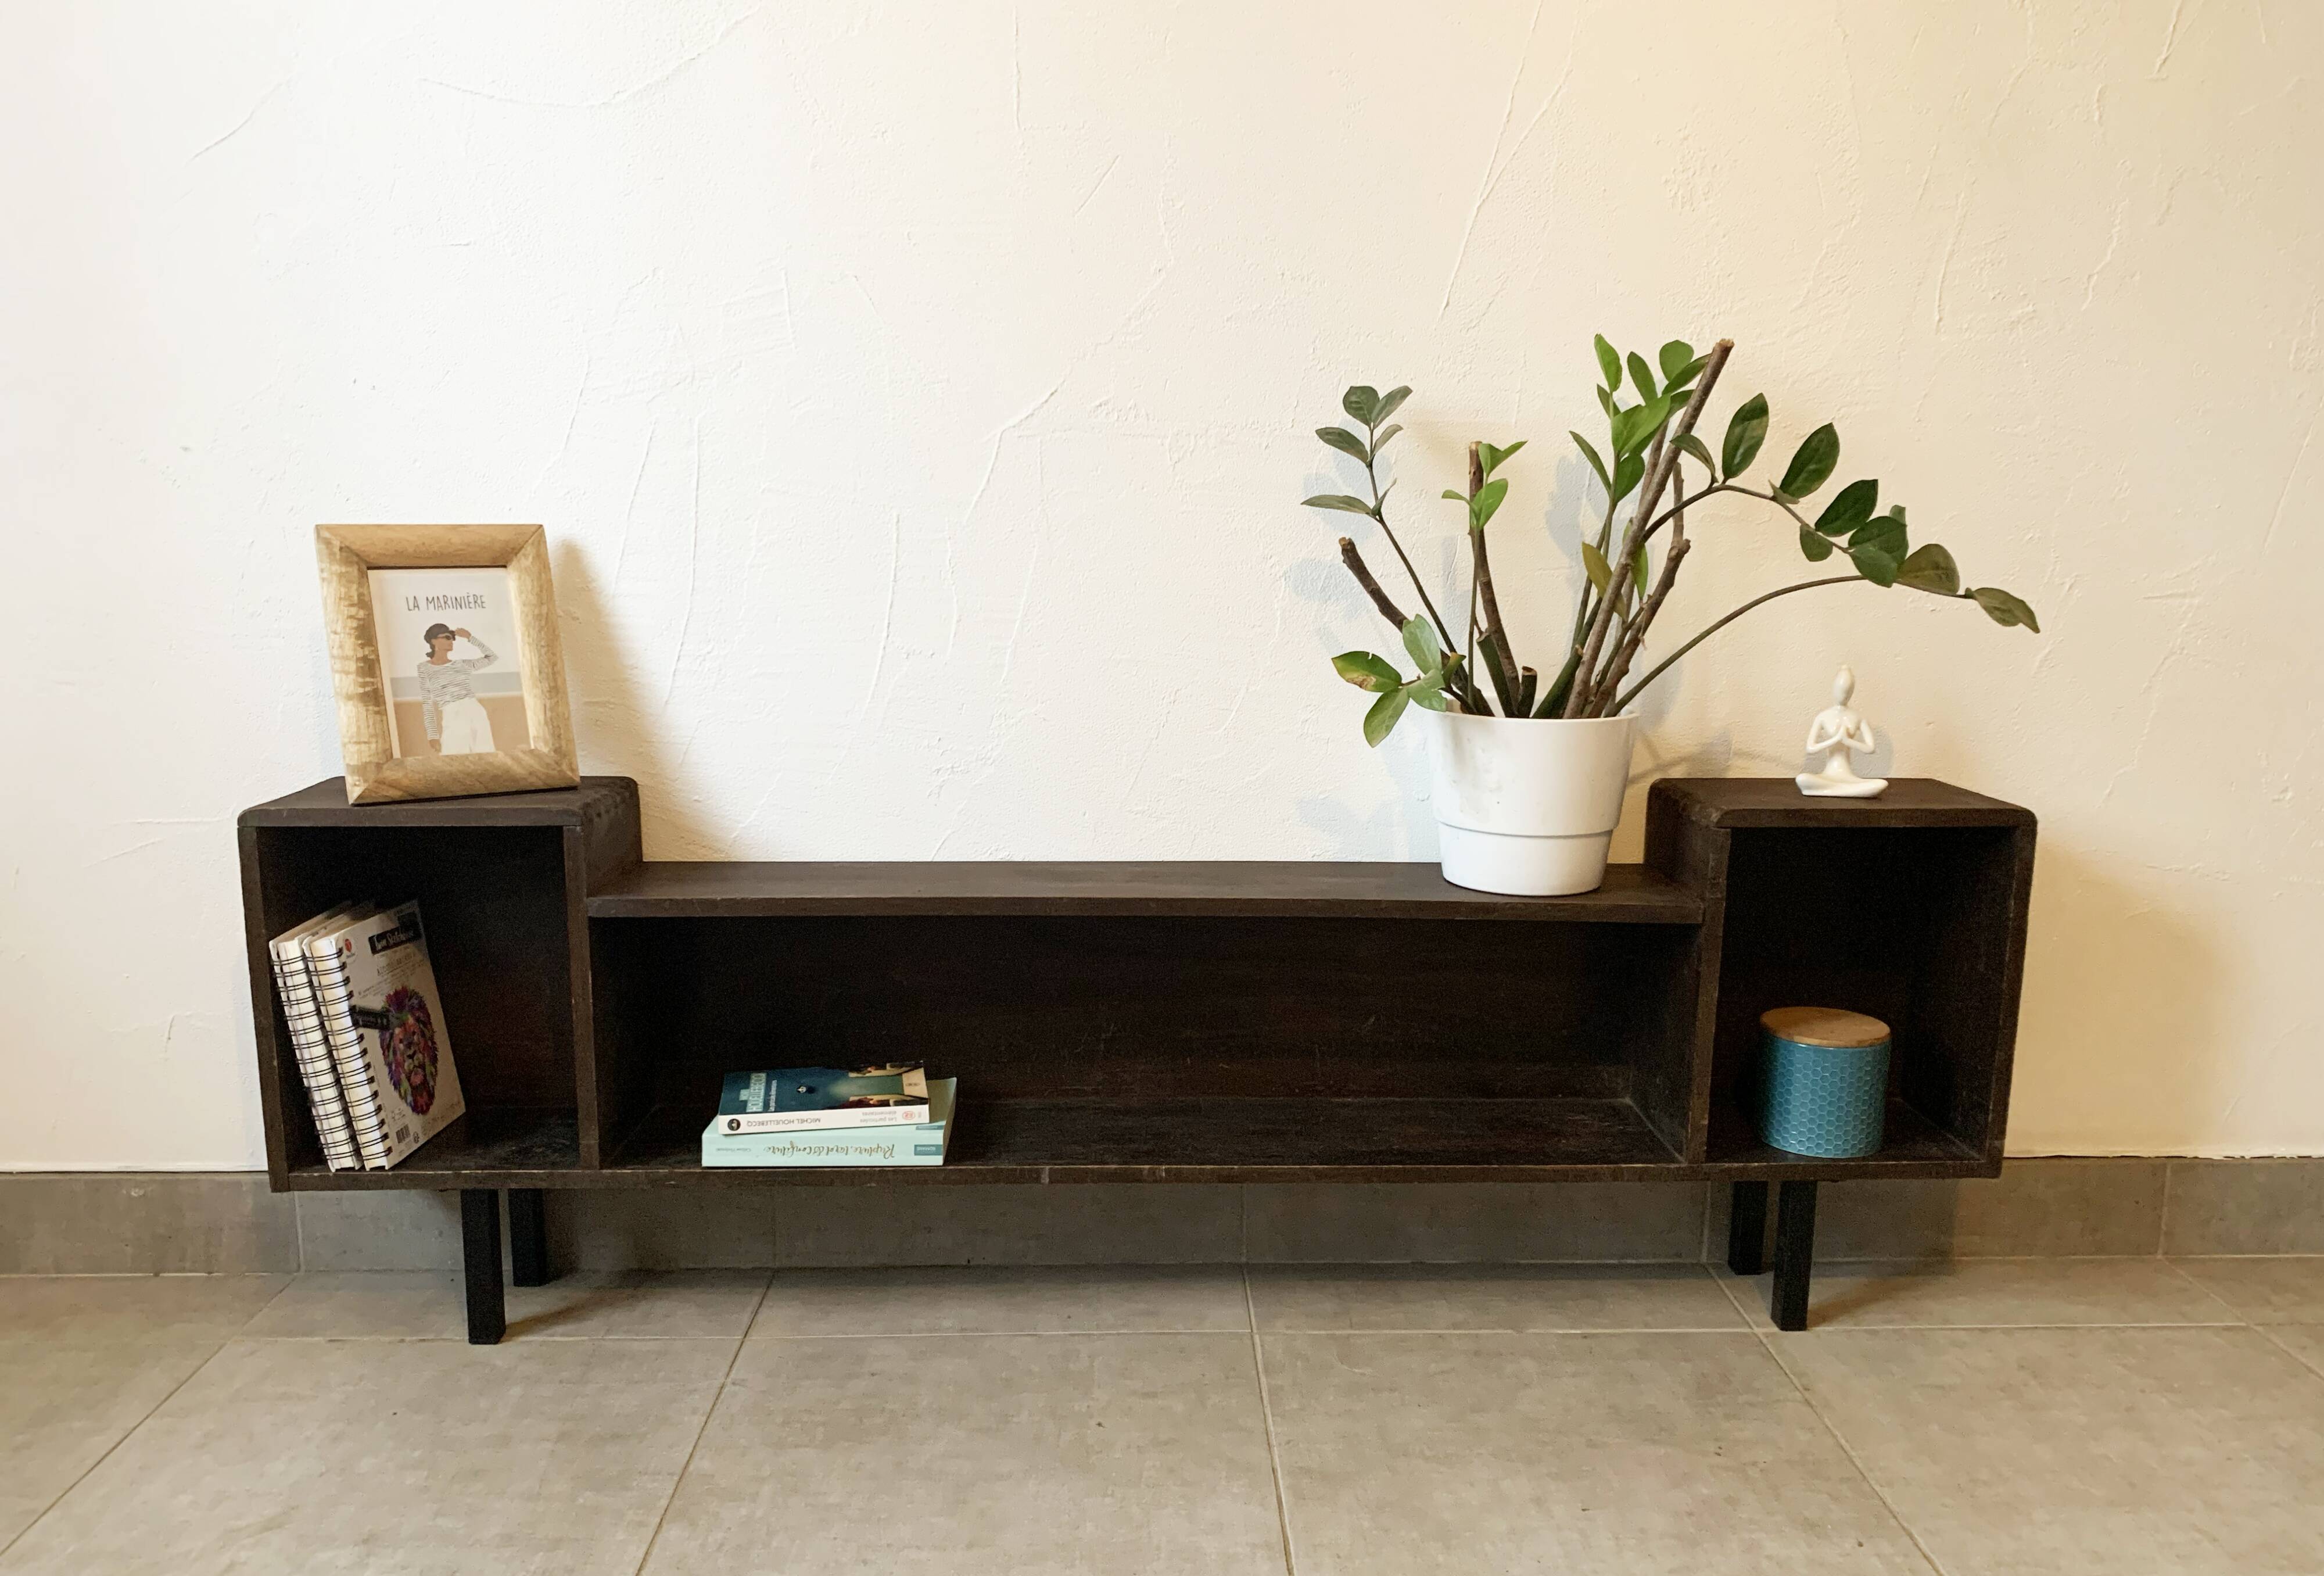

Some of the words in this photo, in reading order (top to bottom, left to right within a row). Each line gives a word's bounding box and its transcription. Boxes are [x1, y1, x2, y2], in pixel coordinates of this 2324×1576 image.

[406, 595, 420, 611] LA
[425, 592, 486, 611] MARINIÈRE
[746, 1119, 794, 1127] HOUELLEBECQ
